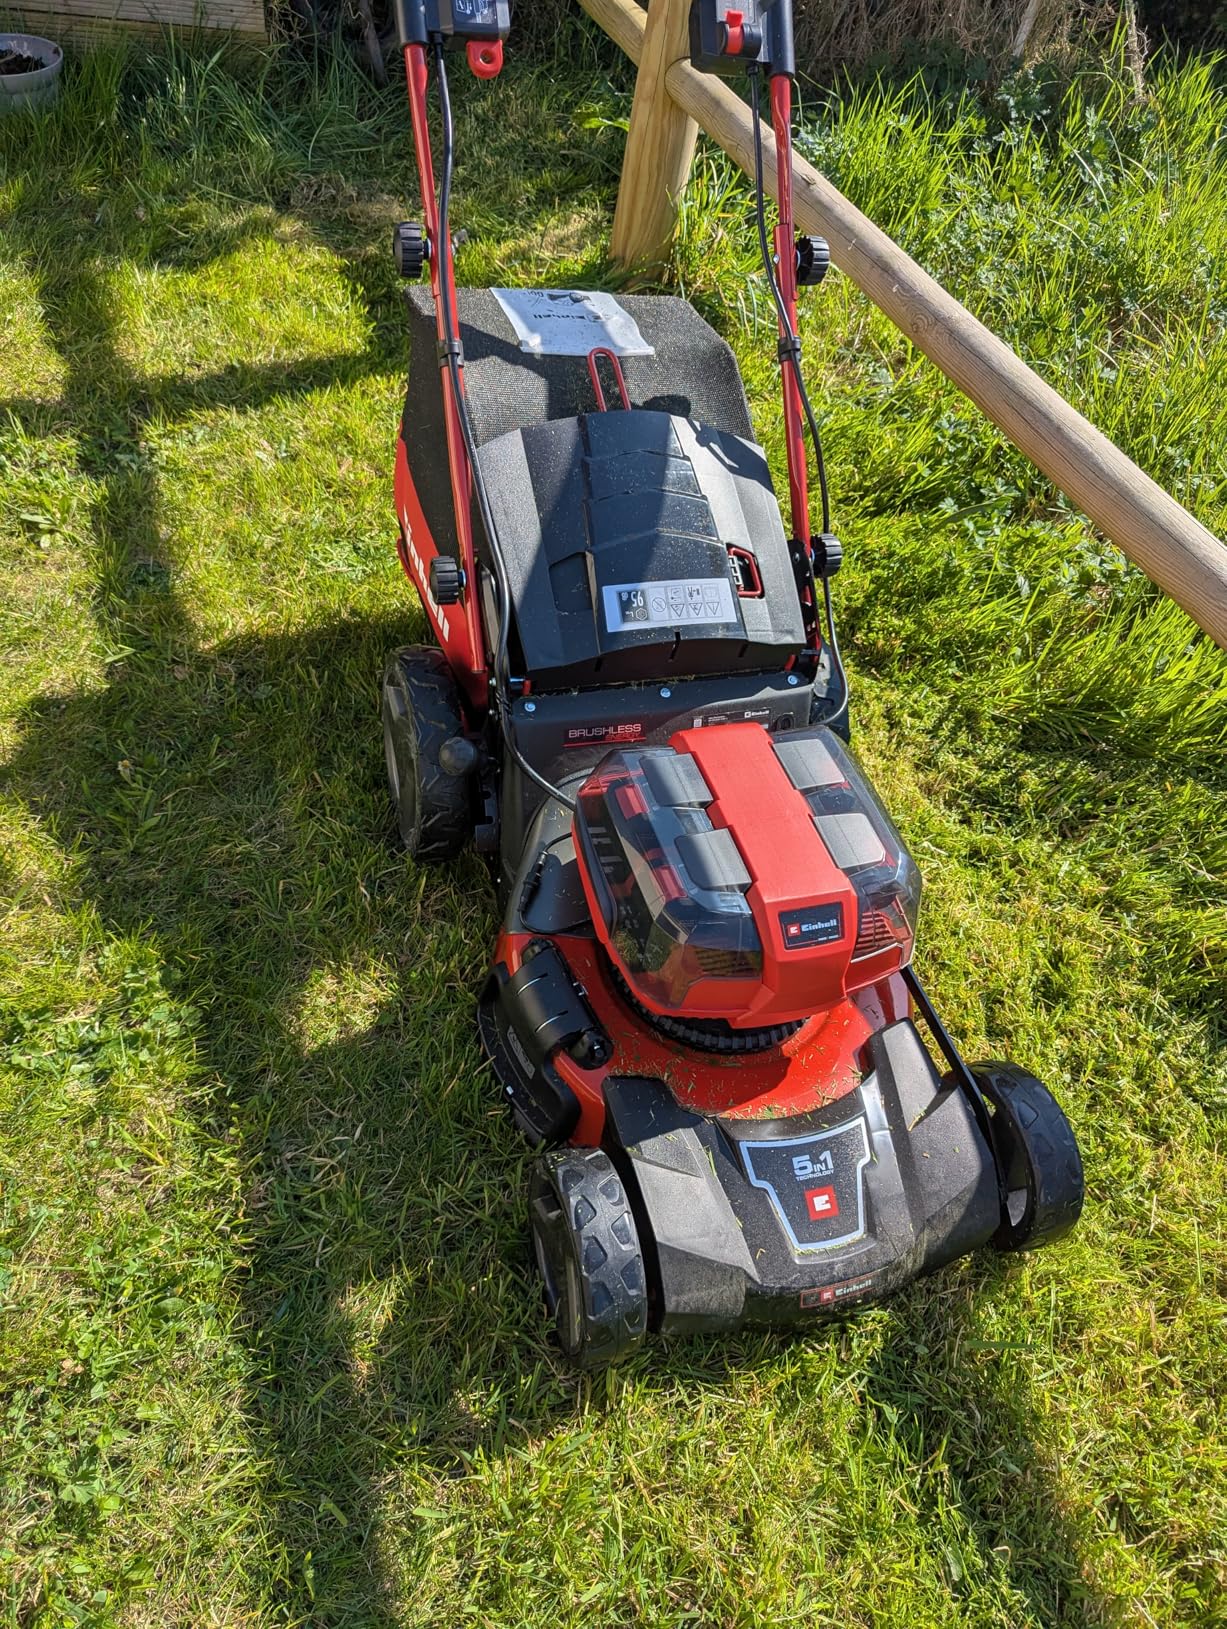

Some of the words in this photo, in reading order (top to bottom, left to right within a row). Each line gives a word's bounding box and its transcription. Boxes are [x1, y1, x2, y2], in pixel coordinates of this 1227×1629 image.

[631, 591, 644, 607] 95
[568, 723, 642, 738] BRUSHLESS
[605, 732, 642, 741] ENERGY
[801, 918, 838, 932] Einhell
[795, 1169, 834, 1182] TECHNOLOGY
[835, 1279, 872, 1297] Einhell
